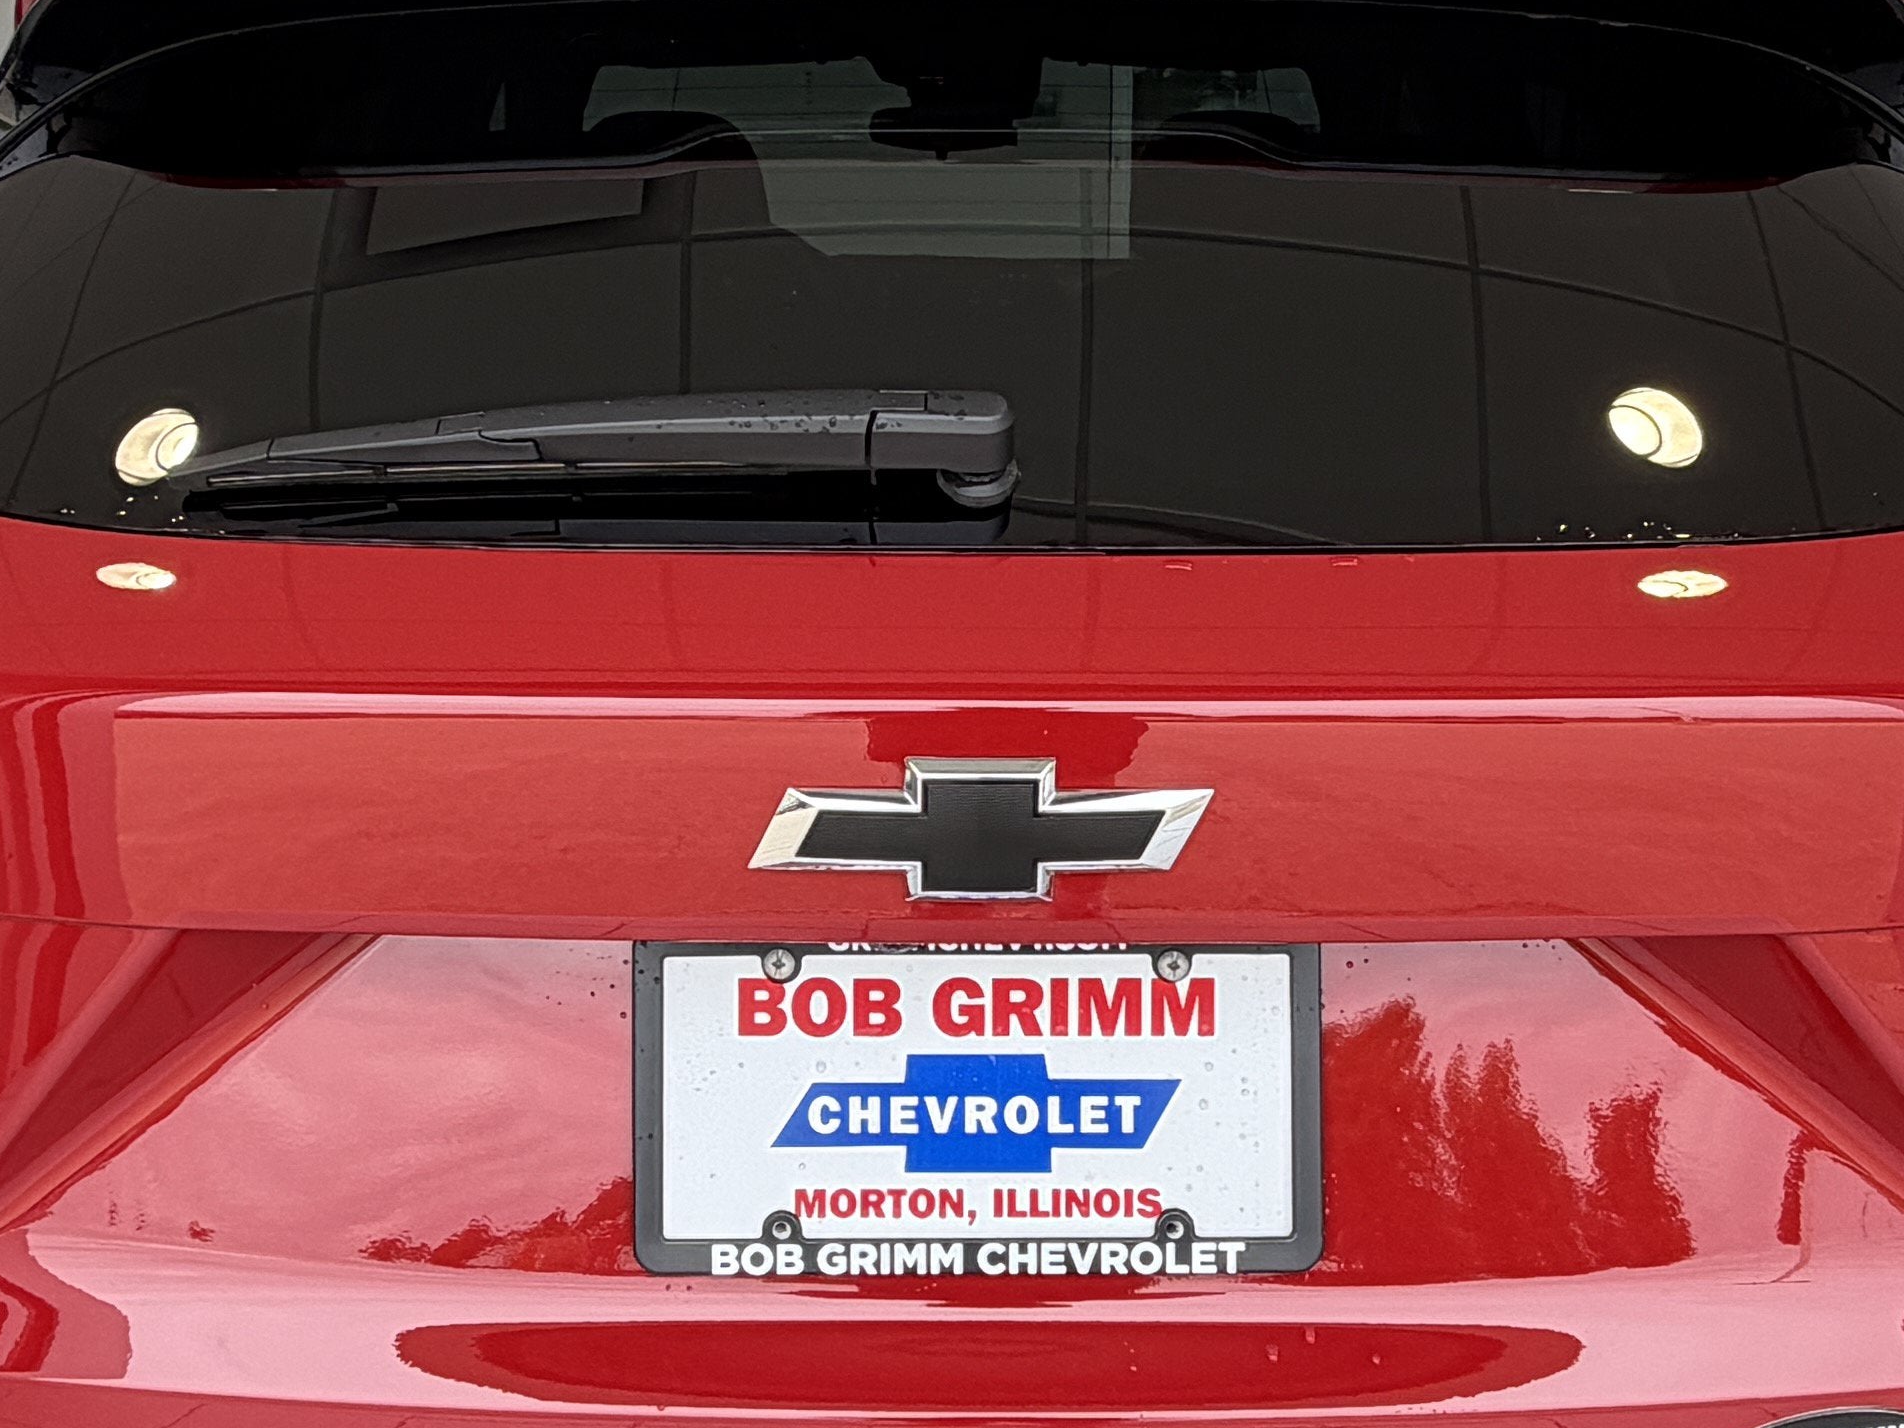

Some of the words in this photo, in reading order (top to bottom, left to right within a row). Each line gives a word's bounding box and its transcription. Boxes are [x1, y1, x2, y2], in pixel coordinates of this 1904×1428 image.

[738, 977, 902, 1036] BOB
[932, 977, 1215, 1036] GRIMM
[807, 1094, 1142, 1134] CHEVROLET
[794, 1188, 977, 1225] MORTON,
[993, 1188, 1162, 1219] ILLINOIS
[711, 1243, 804, 1275] BOB
[816, 1243, 964, 1275] GRIMM
[977, 1243, 1246, 1275] CHEVROLET
